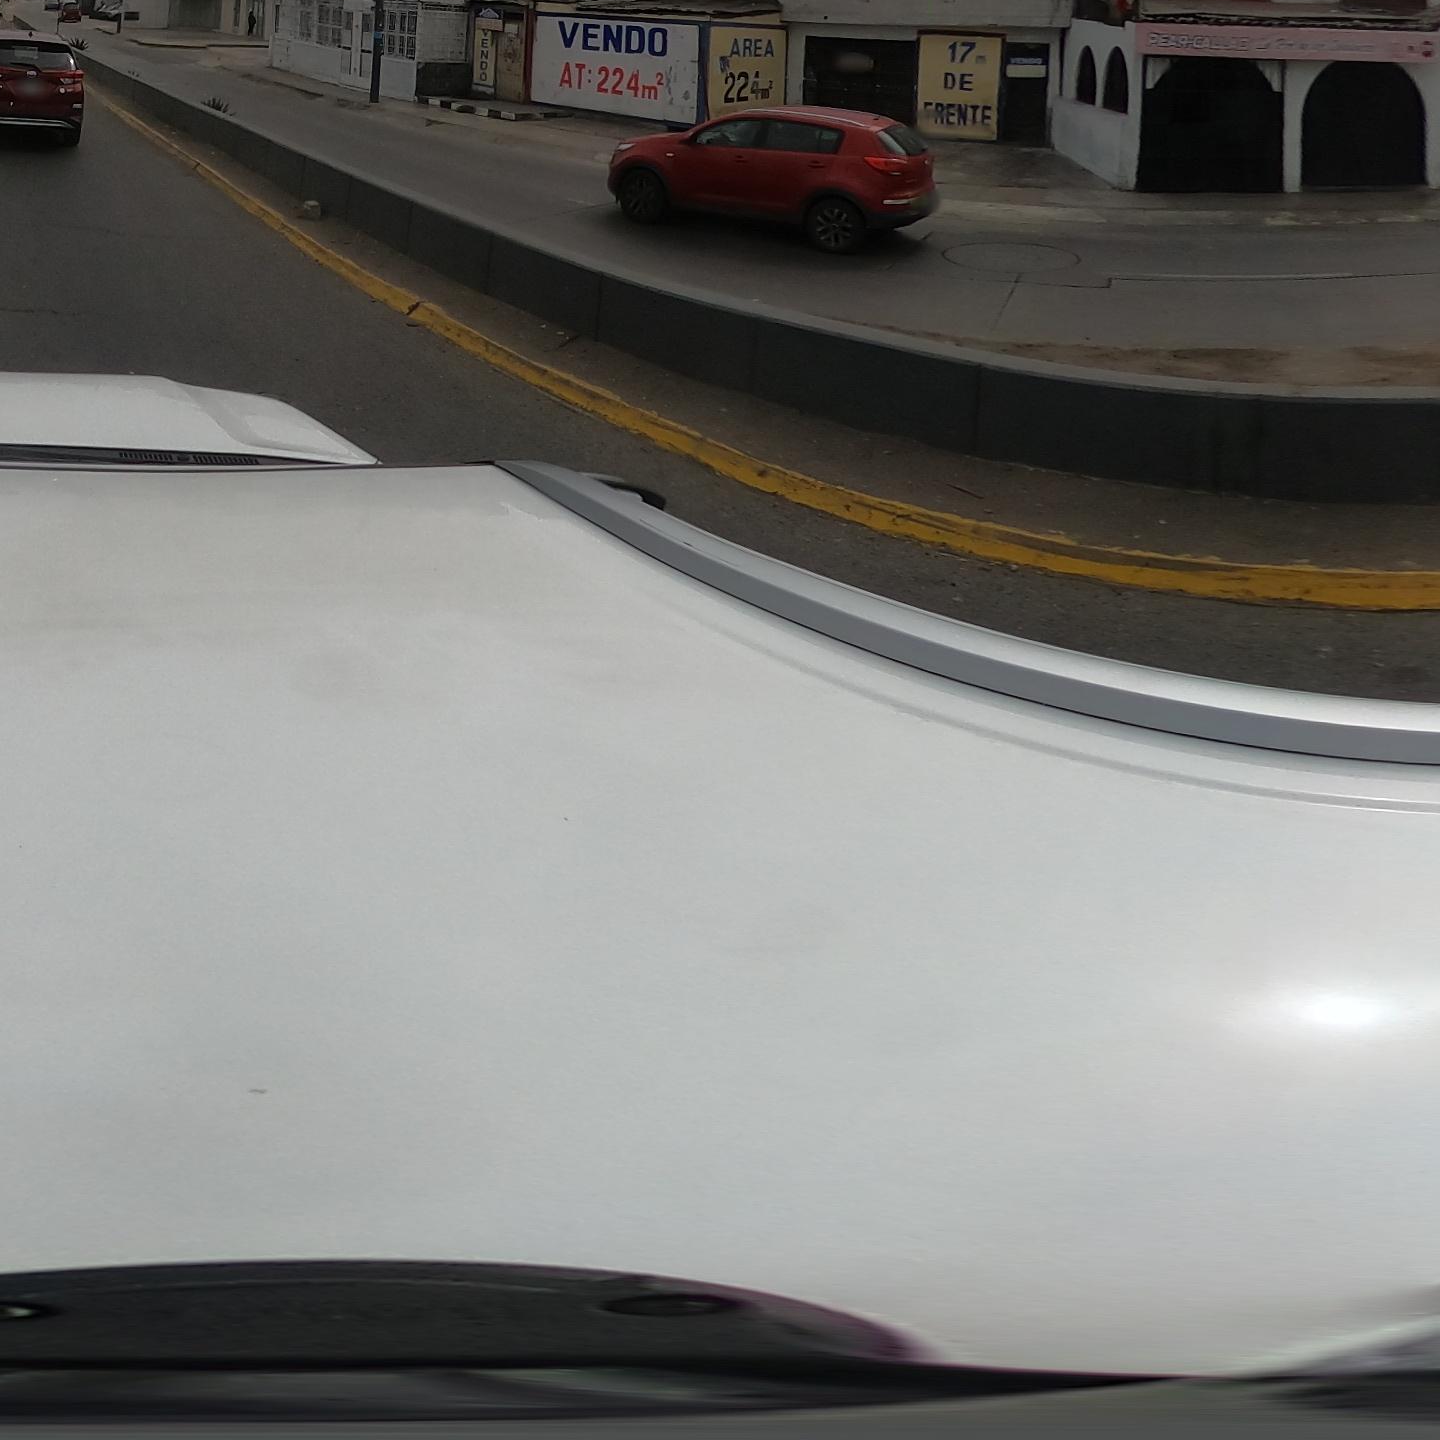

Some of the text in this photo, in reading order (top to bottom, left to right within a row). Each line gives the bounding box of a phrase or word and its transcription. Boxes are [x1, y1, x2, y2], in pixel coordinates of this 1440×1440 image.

[558, 20, 668, 57] VENDO
[730, 38, 775, 57] AREA
[480, 29, 490, 82] VENDO
[943, 72, 974, 91] DE
